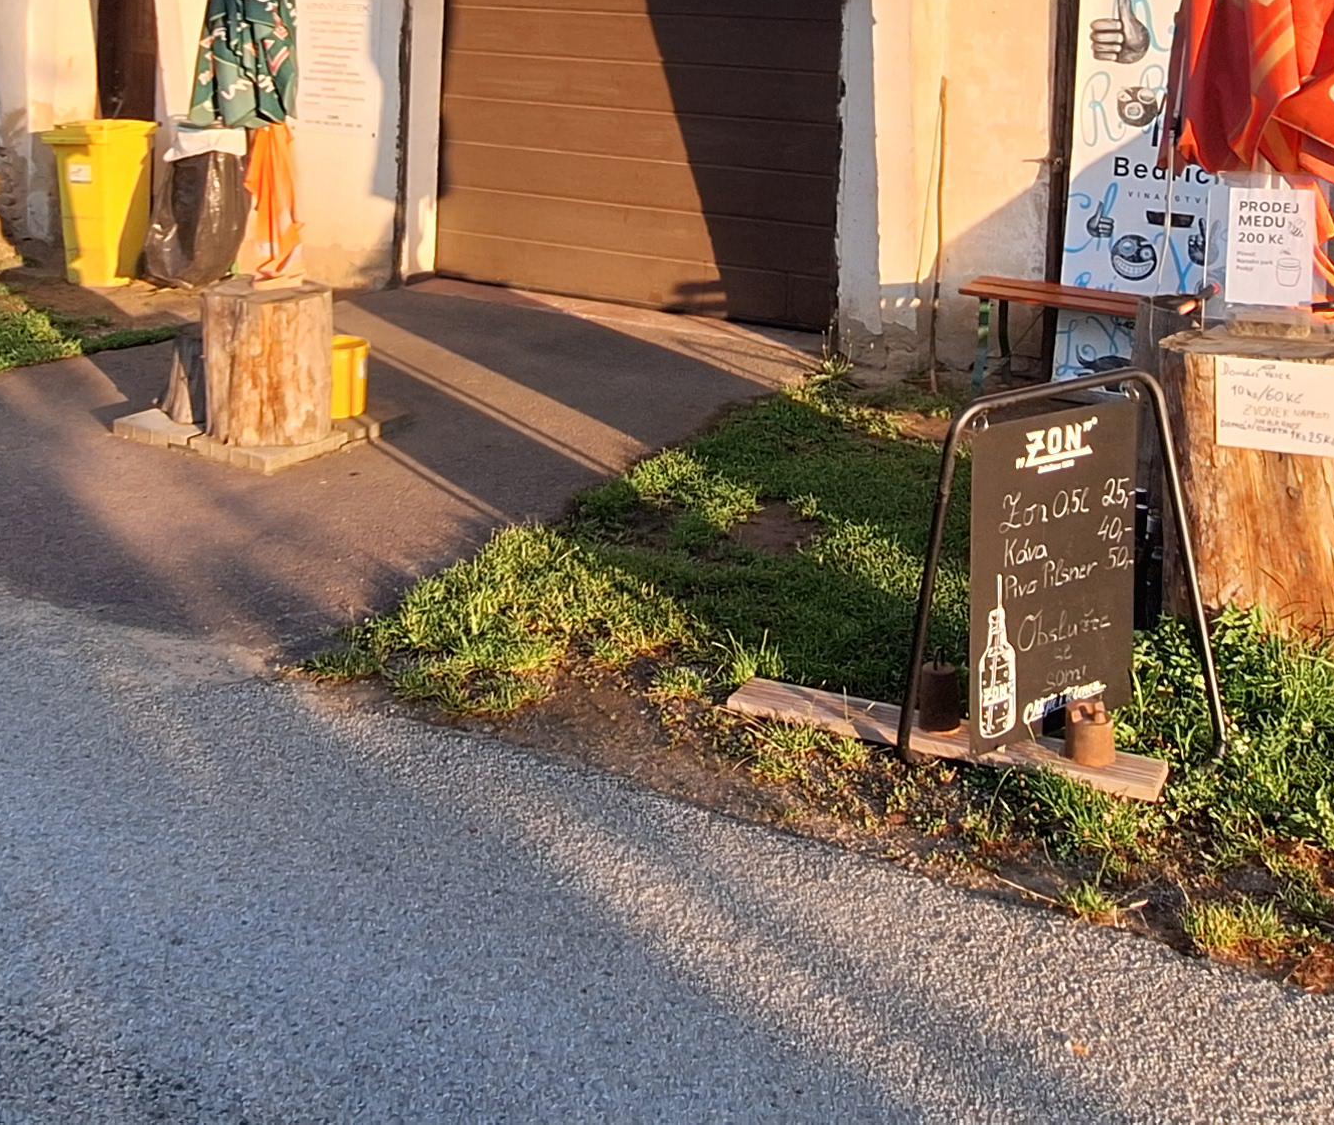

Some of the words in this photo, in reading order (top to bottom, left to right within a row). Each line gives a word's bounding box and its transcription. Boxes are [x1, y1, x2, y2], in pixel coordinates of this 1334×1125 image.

[1238, 200, 1300, 215] PRODEJ
[1237, 214, 1286, 229] MEDU
[1237, 232, 1264, 245] 200
[1268, 233, 1285, 246] Kč
[1003, 538, 1049, 568] Káva
[1004, 575, 1039, 601] Pivo
[1042, 557, 1099, 589] Pilsner
